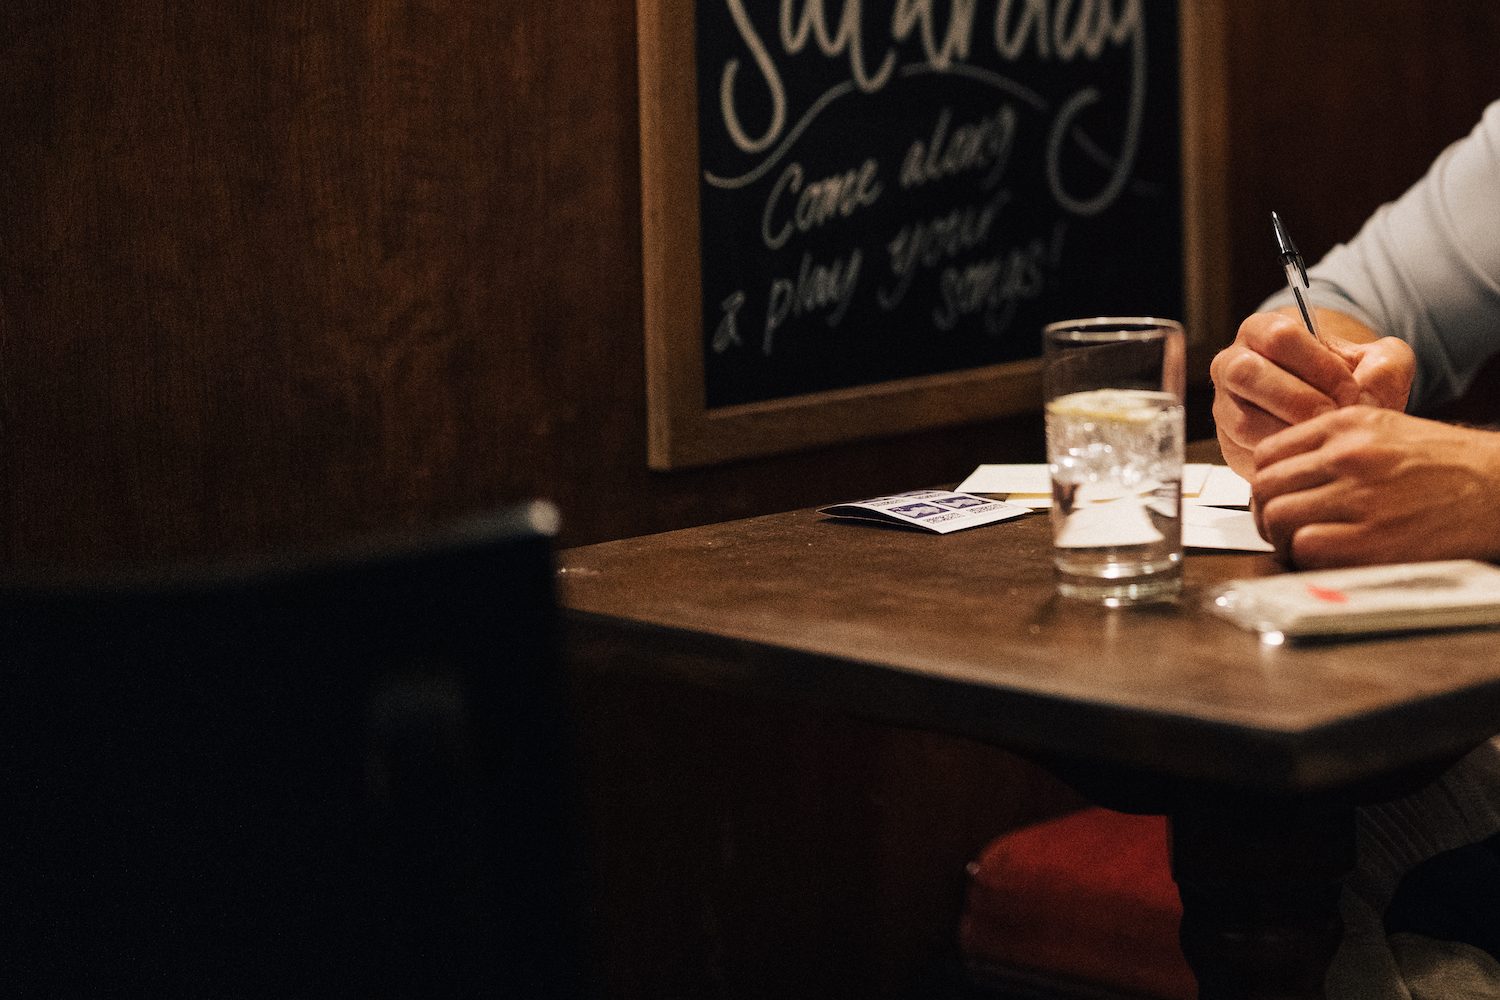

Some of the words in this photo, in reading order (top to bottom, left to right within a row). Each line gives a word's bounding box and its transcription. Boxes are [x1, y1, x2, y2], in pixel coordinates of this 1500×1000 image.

[761, 157, 884, 251] Come
[900, 103, 1017, 191] along
[762, 247, 863, 356] play
[877, 187, 1012, 311] your
